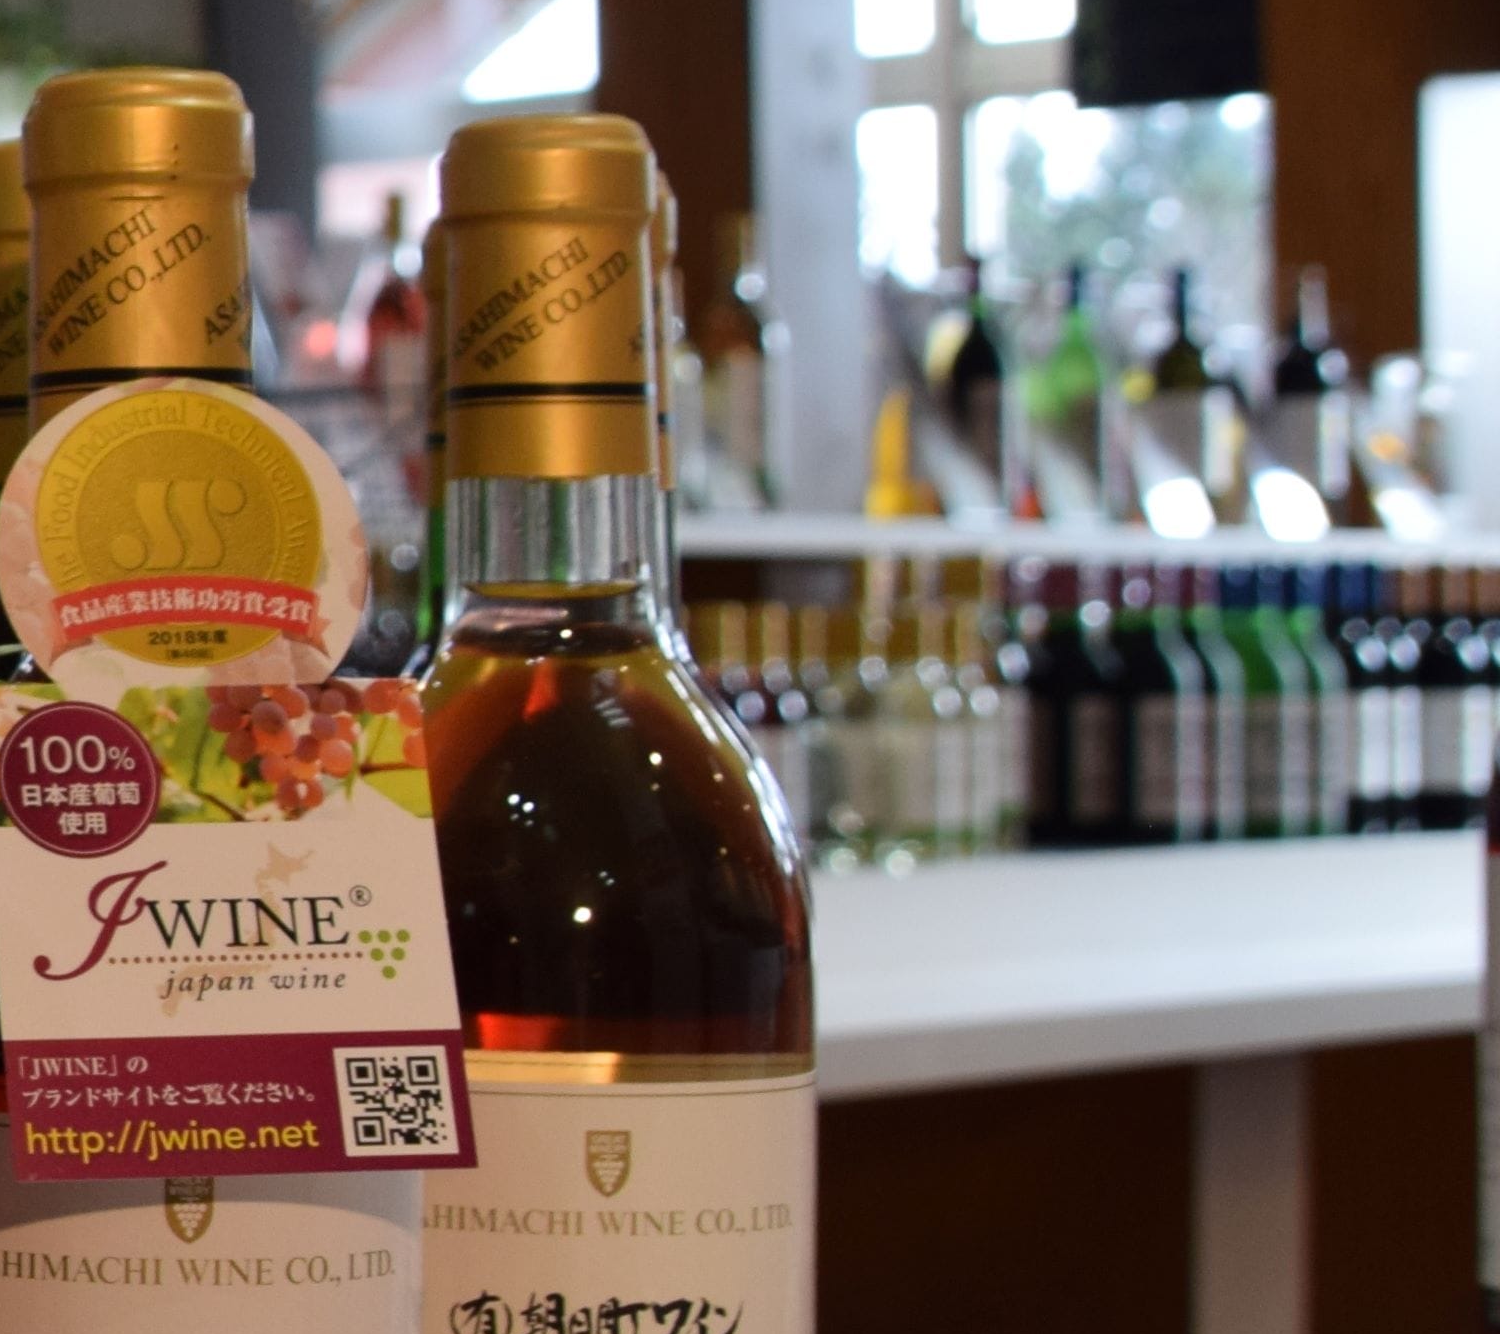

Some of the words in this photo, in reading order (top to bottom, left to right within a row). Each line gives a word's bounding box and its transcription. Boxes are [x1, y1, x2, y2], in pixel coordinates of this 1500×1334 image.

[49, 298, 108, 356] WINE
[474, 315, 544, 371] WINE
[18, 734, 137, 776] 100%
[20, 781, 141, 809] 日本産葡萄
[57, 812, 108, 837] 使用
[159, 969, 256, 1002] japan
[269, 970, 347, 991] wine
[21, 1081, 316, 1111] ブランドサイトをご覧ください。
[23, 1119, 321, 1165] http://jwine.net
[422, 1204, 585, 1237] HIMACHI
[596, 1209, 686, 1237] WINE
[176, 1257, 274, 1287] WINE
